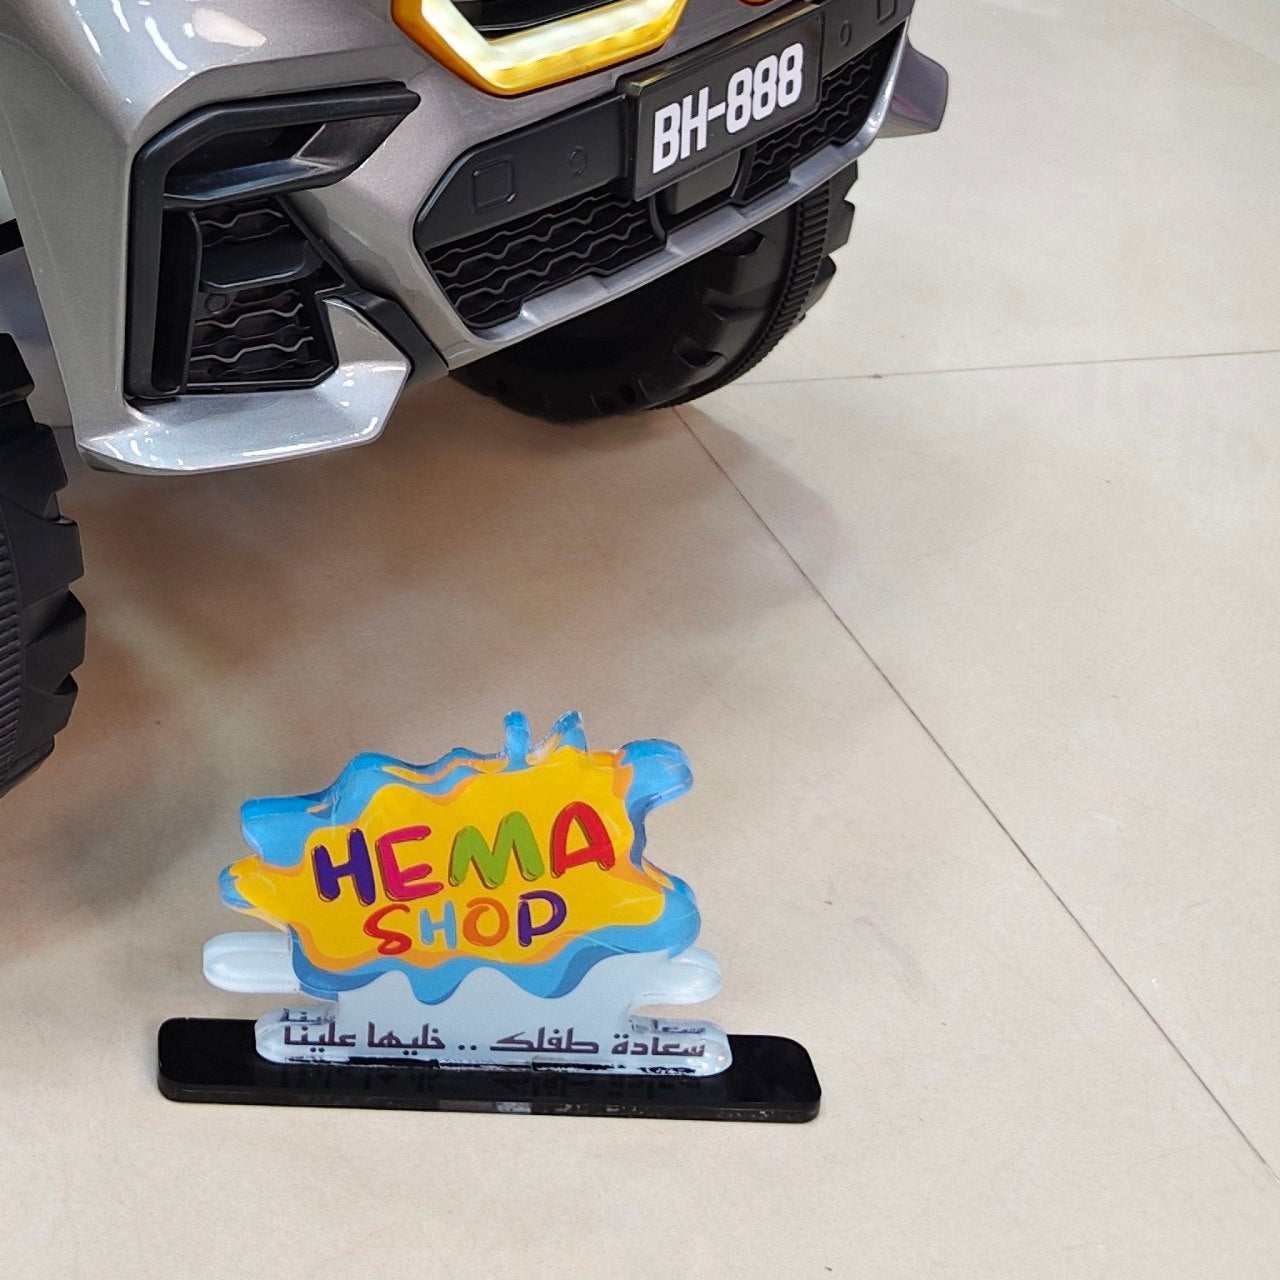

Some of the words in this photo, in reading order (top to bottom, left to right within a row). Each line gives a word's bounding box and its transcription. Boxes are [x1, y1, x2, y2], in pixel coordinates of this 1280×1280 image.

[652, 42, 804, 174] BH-888
[310, 800, 616, 906] HEMA
[363, 889, 568, 956] SHOP
[284, 1021, 356, 1053] علينا
[367, 1021, 446, 1056] خليها
[489, 1025, 599, 1054] طفلك
[611, 1032, 706, 1057] سعادة
